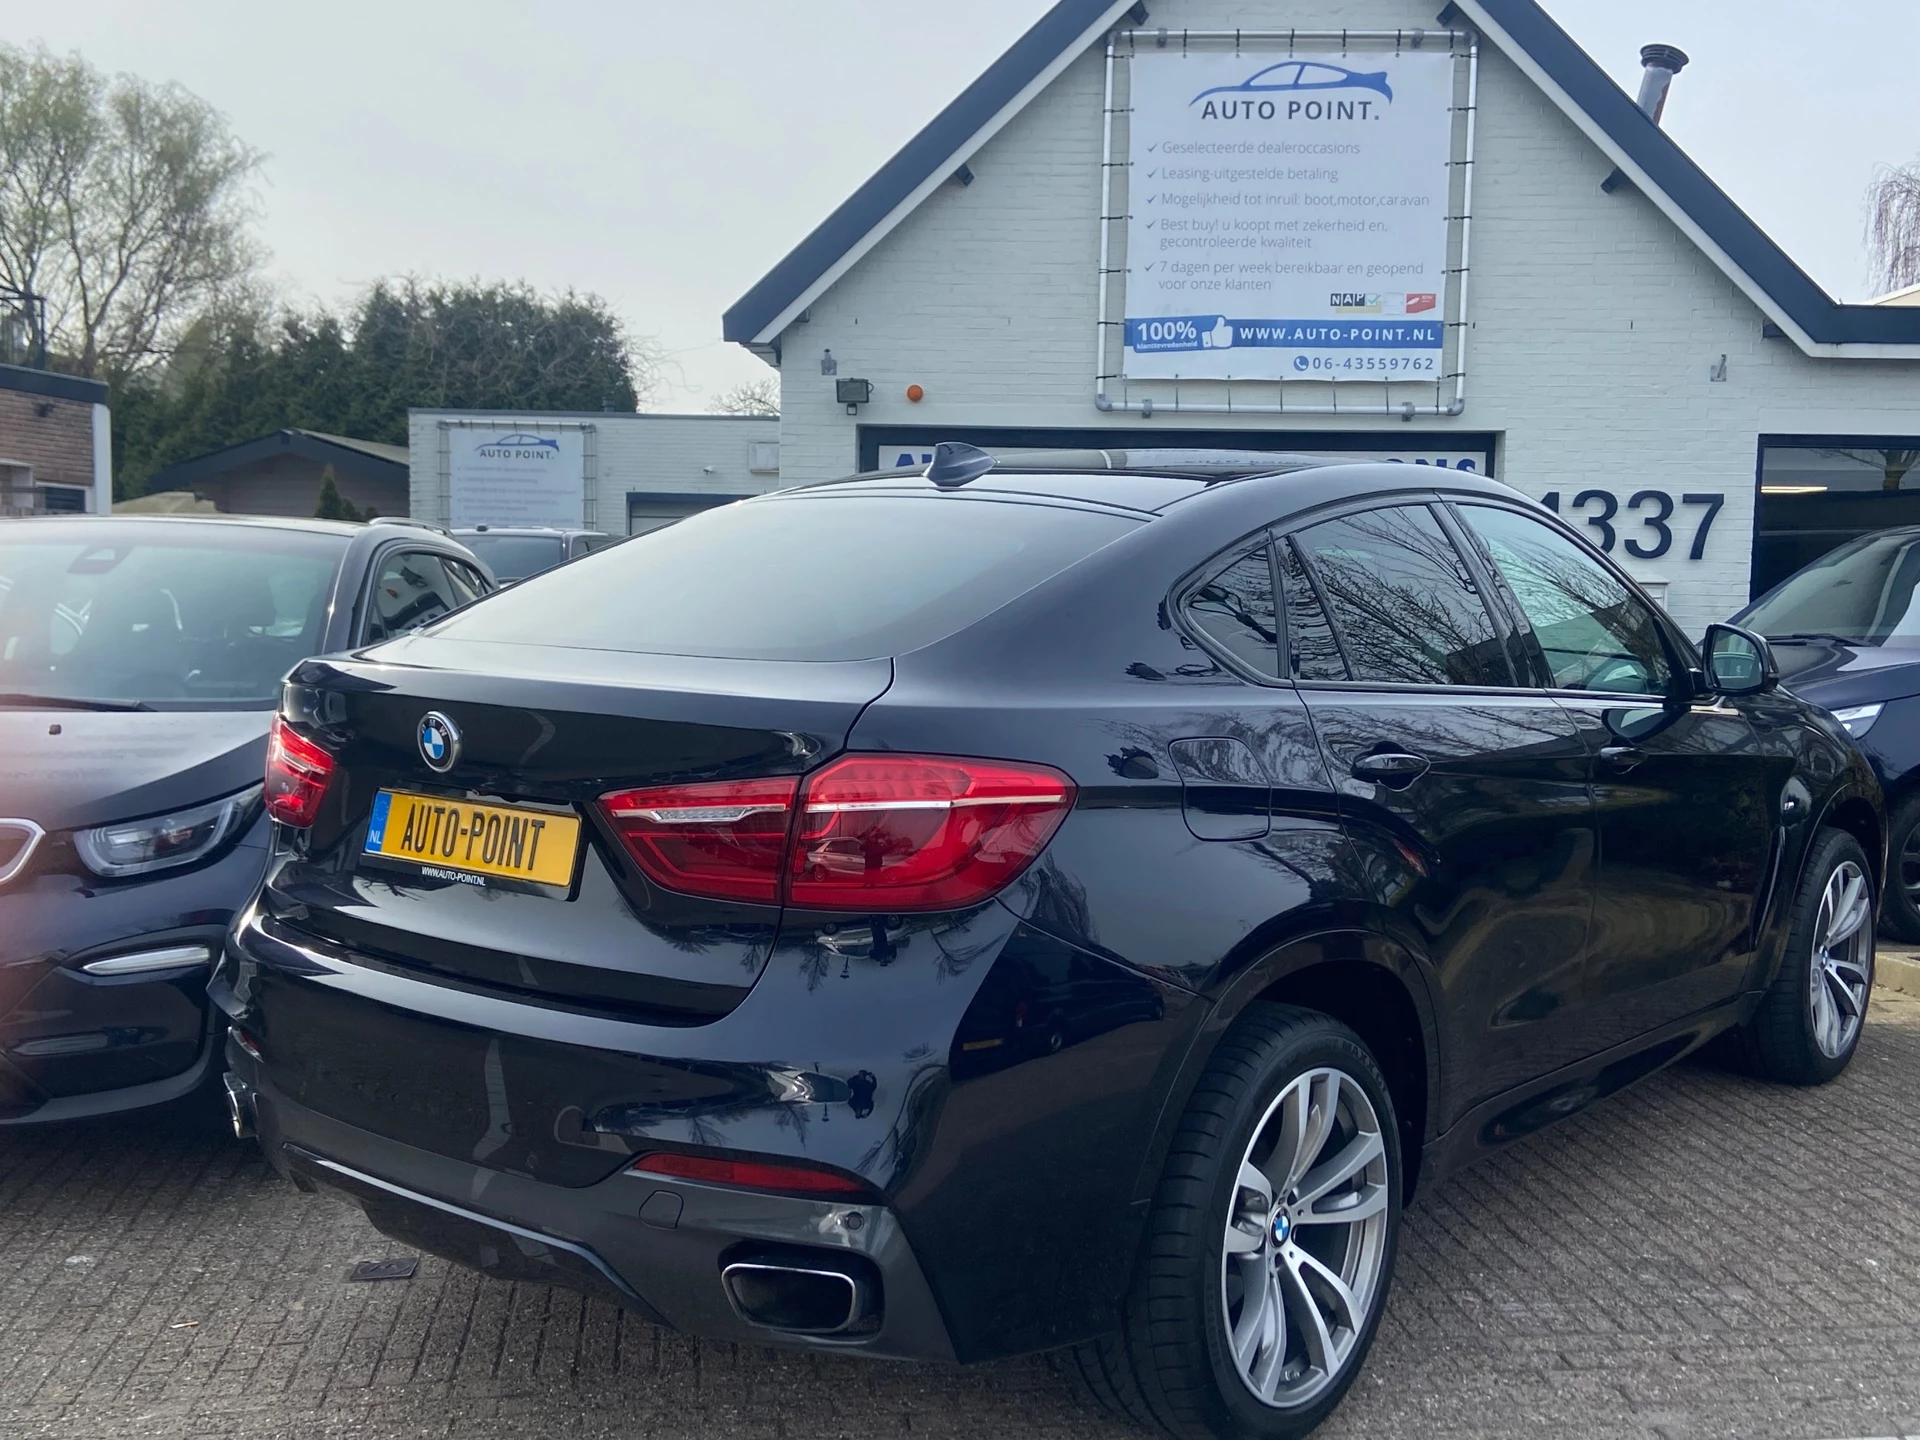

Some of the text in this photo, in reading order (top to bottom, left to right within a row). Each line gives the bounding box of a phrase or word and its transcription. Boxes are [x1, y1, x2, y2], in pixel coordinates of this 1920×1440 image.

[1201, 100, 1380, 121] AUTO POINT.
[1162, 141, 1361, 155] Geselecteerde dealeroccasions
[1161, 167, 1339, 183] Leasing-uitgestelde betaling
[1161, 192, 1242, 208] Mogelijkheid
[1244, 194, 1261, 205] tot
[1304, 193, 1430, 208] boot,motor,caravan
[1161, 218, 1189, 231] Best
[1192, 219, 1219, 235] buy!
[1222, 222, 1230, 231] u
[1234, 219, 1270, 235] koopt
[1274, 220, 1299, 231] met
[1302, 219, 1365, 232] zekerheid
[1159, 236, 1312, 250] gecontroleerde kwaliteit
[1159, 261, 1424, 277] 7 dagen per week bereikbaar en geopend
[1158, 278, 1271, 290] voor onze klanten
[1331, 293, 1366, 306] NAP
[1137, 320, 1197, 341] 100%
[1239, 327, 1435, 341] WWW.AUTO-POINT.NL
[1312, 357, 1434, 370] 06-43559762
[479, 449, 511, 459] AUTO
[421, 718, 448, 737] BMW
[369, 830, 382, 845] NL
[400, 803, 546, 871] AUTO-POINT
